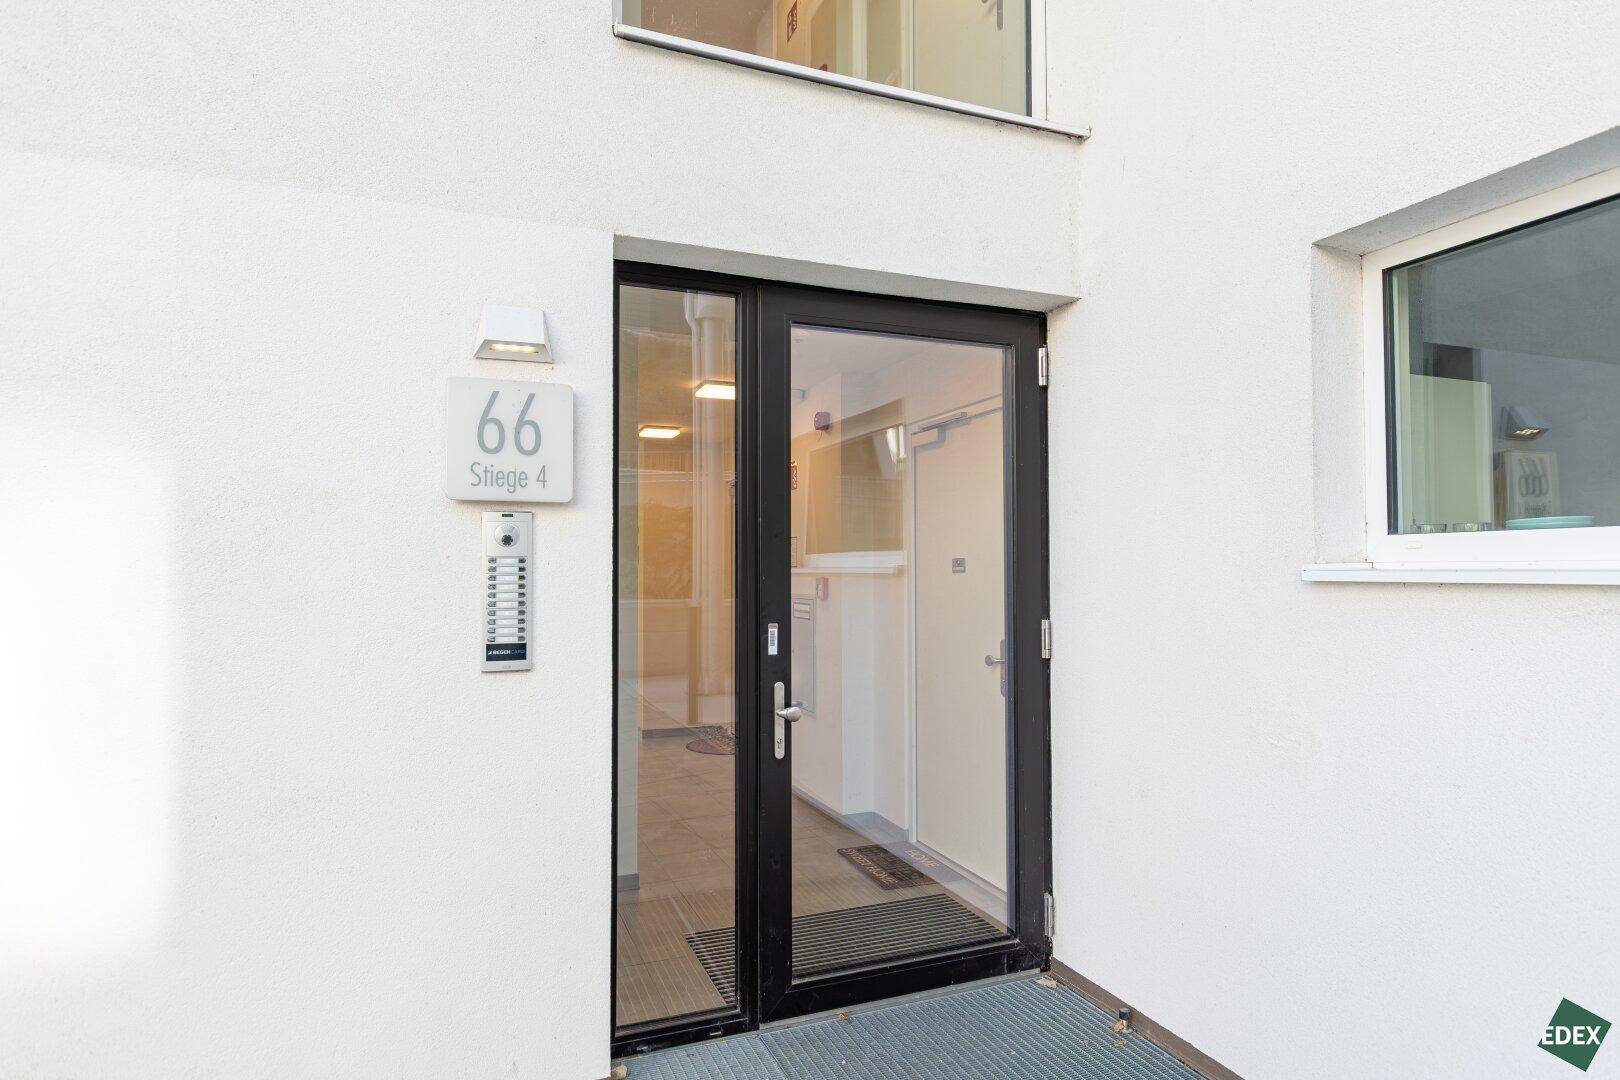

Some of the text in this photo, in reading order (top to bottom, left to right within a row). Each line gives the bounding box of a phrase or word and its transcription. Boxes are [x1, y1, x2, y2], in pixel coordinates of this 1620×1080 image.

[477, 390, 542, 456] 66
[470, 461, 548, 494] Stiege 4
